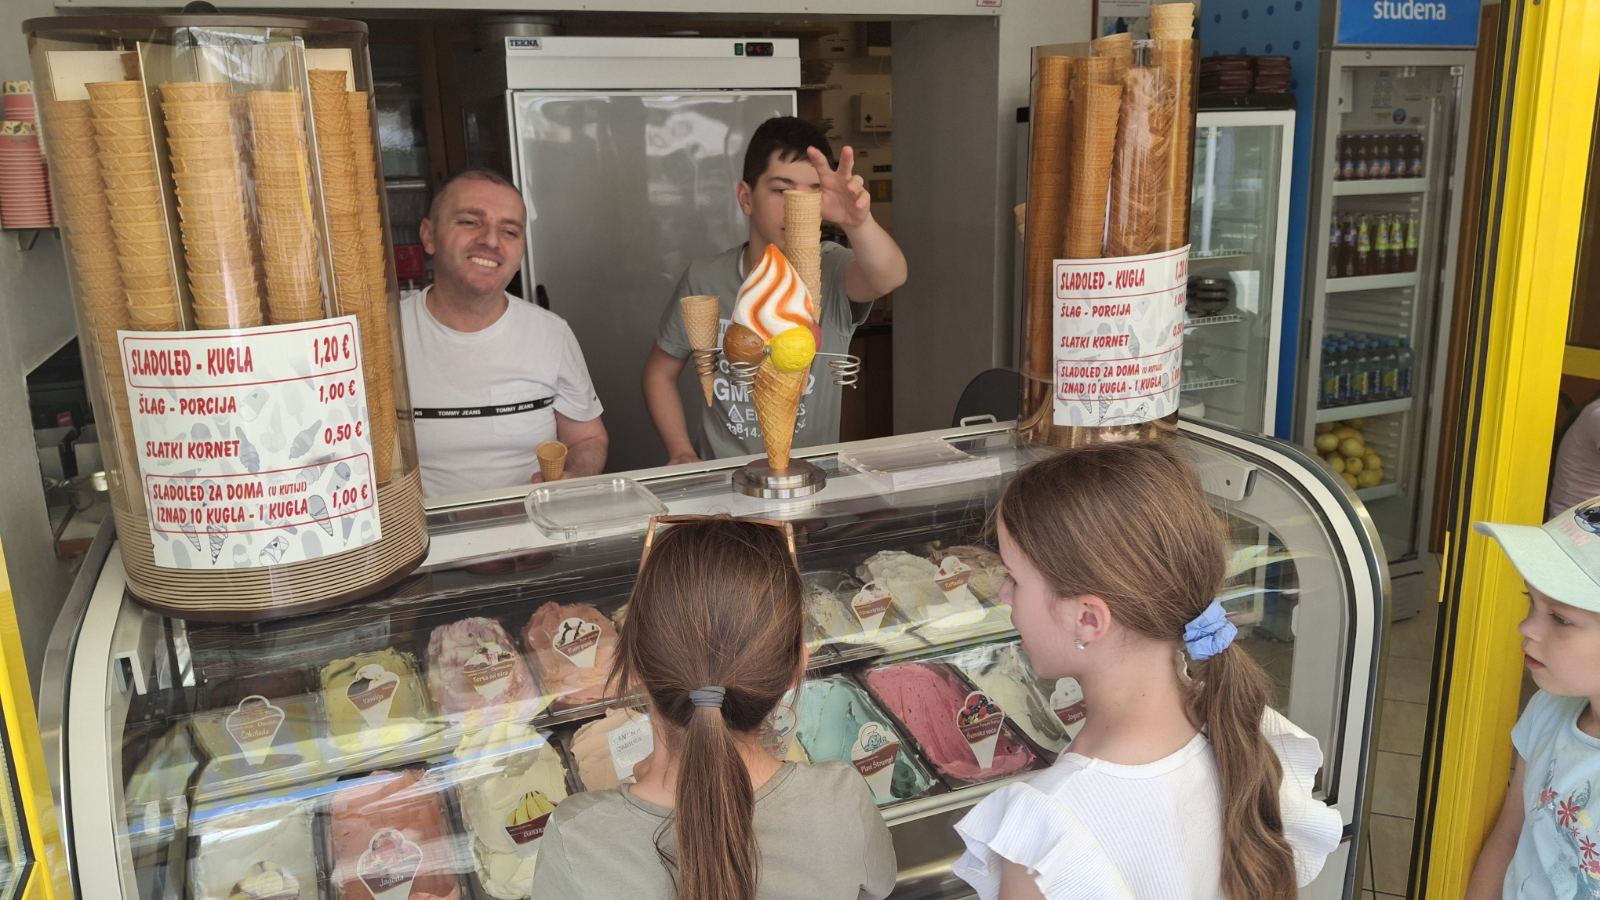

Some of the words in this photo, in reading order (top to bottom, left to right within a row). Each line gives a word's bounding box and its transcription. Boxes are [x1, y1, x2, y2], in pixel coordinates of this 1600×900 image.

[1373, 0, 1446, 20] studena
[510, 39, 540, 47] TEKNA
[1060, 271, 1105, 291] SLADOLED
[1115, 268, 1145, 290] KUGLA
[1060, 303, 1081, 318] ŠLAG
[1092, 303, 1131, 318] PORCIJA
[1060, 335, 1089, 349] SLATKI
[1093, 334, 1130, 348] KORNET
[131, 348, 191, 377] SLADOLED
[207, 346, 253, 376] KUGLA
[313, 336, 338, 367] 1,20
[342, 334, 350, 360] €
[1061, 366, 1100, 378] SLADOLED
[1103, 366, 1113, 378] ZA
[1116, 364, 1139, 377] DOMA
[1061, 382, 1085, 394] IZNAD
[1087, 382, 1097, 394] 10
[1100, 381, 1126, 394] KUGLA
[1141, 374, 1161, 391] KUGLA
[139, 393, 165, 415] ŠLAG
[180, 396, 236, 416] PORCIJA
[319, 382, 345, 404] 1,00
[348, 380, 355, 395] €
[518, 403, 534, 411] JEANS
[146, 441, 183, 458] SLATKI
[188, 440, 240, 458] KORNET
[324, 423, 351, 446] 0,50
[355, 421, 362, 437] €
[153, 484, 204, 502] SLADOLED
[209, 484, 223, 500] ZA
[227, 482, 263, 499] DOMA
[268, 484, 277, 497] (U
[279, 481, 307, 496] KUTIJI)
[157, 507, 187, 524] IZNAD
[190, 507, 201, 524] 10
[206, 506, 245, 525] KUGLA
[259, 504, 264, 521] 1
[268, 498, 308, 521] KUGLA
[332, 487, 358, 509] 1,00
[360, 484, 368, 500] €
